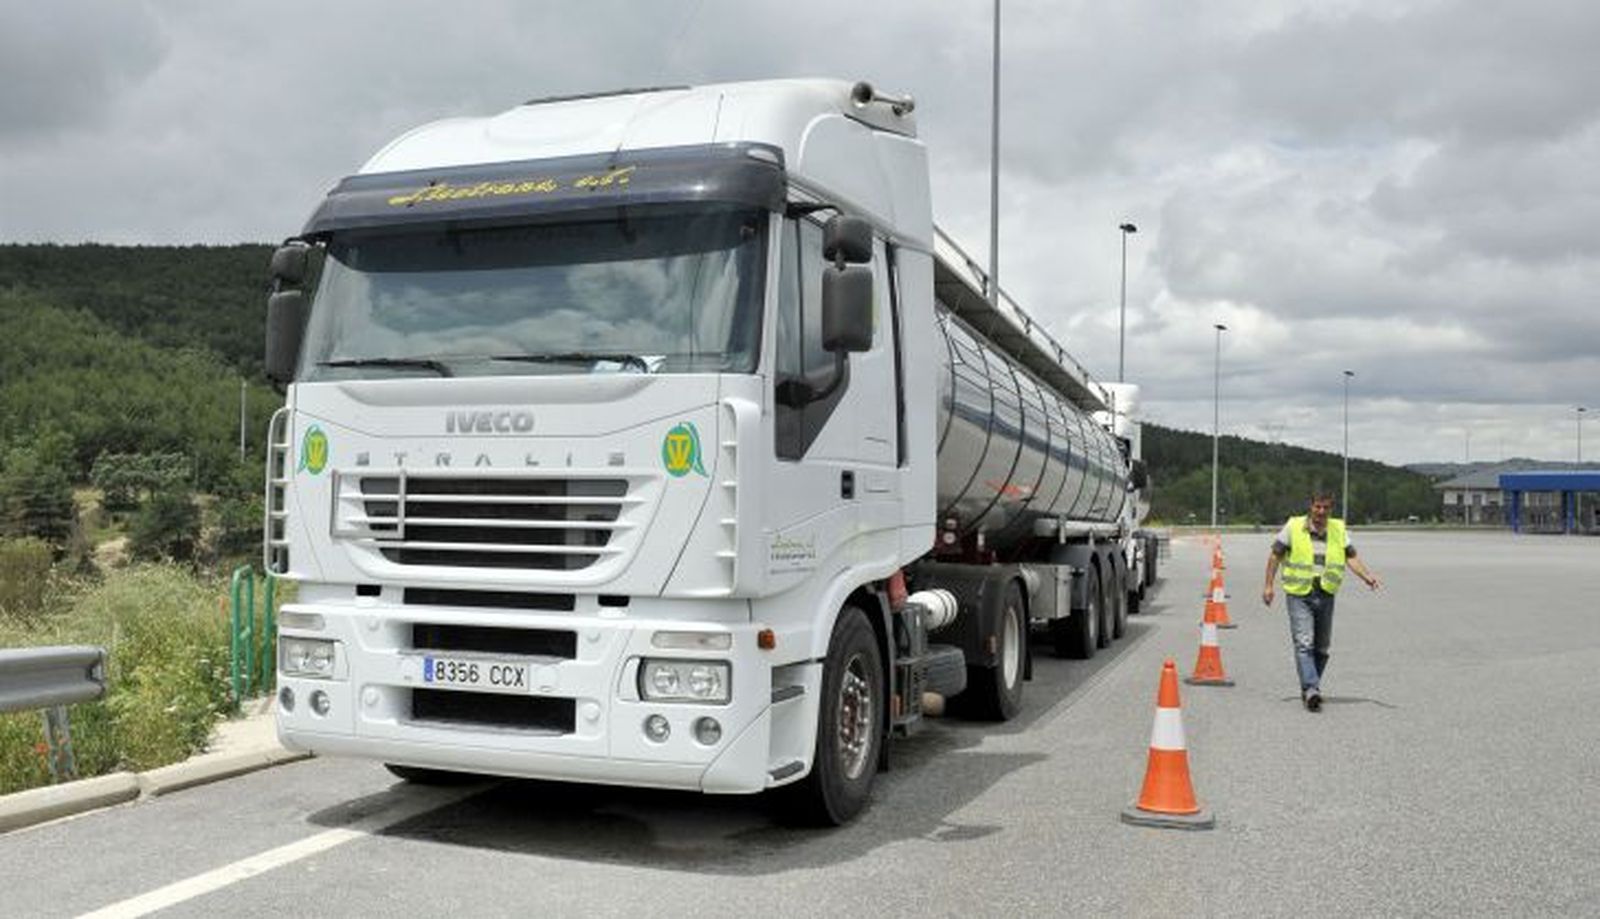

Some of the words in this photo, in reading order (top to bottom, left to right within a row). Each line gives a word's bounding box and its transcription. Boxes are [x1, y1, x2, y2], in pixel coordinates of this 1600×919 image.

[445, 410, 535, 434] IVECO
[355, 452, 626, 467] STRALIS
[435, 660, 480, 684] 8356
[489, 664, 525, 688] CCX
